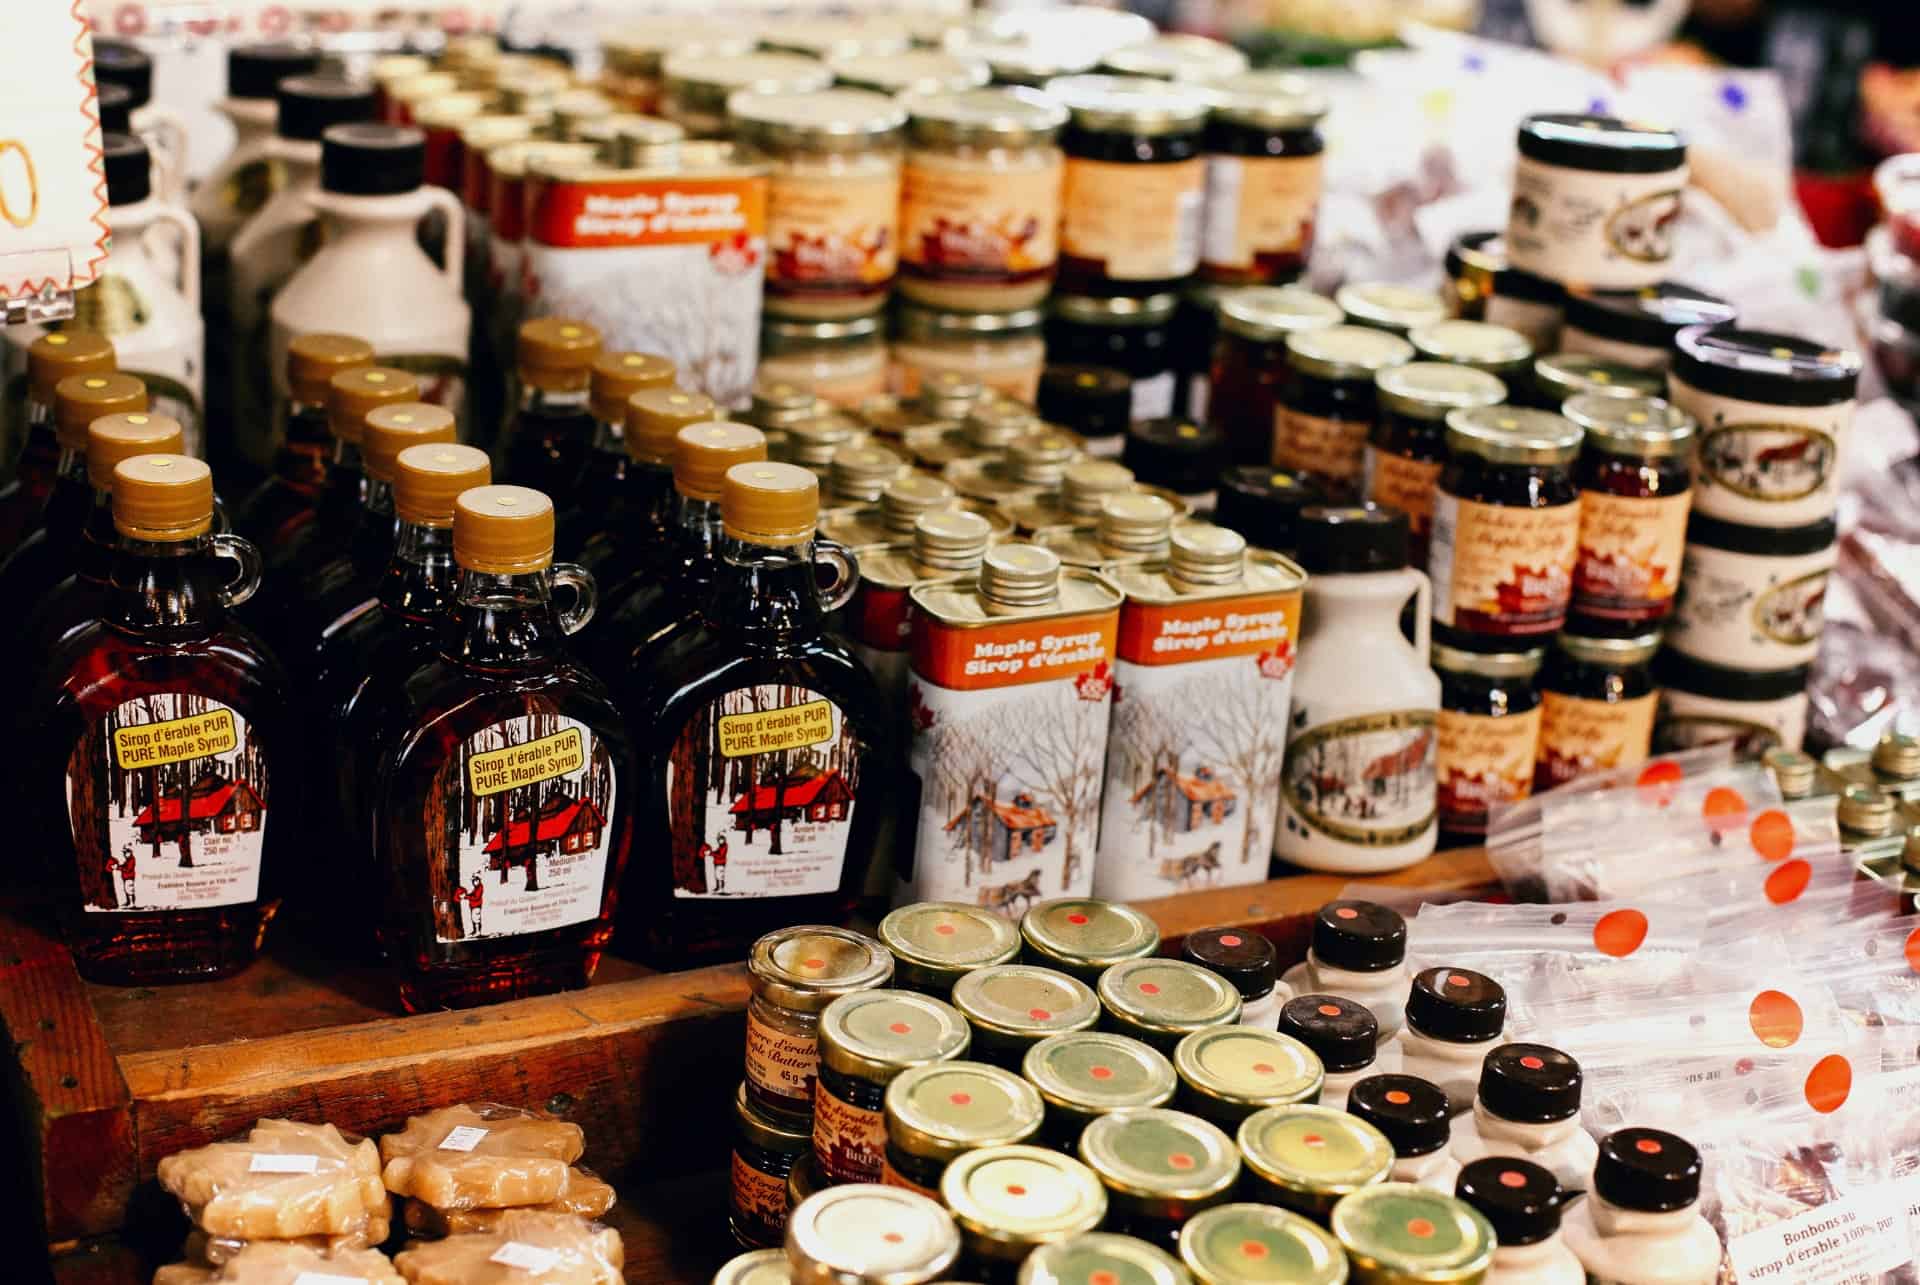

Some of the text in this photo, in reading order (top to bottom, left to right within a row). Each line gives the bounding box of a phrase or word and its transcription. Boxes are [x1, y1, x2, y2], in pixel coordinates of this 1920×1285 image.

[1161, 610, 1285, 635] Maple Syrup
[974, 631, 1101, 658] Maple Syrup
[1152, 635, 1209, 653] Sirop
[964, 658, 1024, 675] Sirop
[119, 715, 229, 748] Sirop d'érable PUR
[723, 707, 827, 735] Sirop d'érable PUR
[122, 734, 230, 763] PURE Maple Syrup
[725, 725, 827, 751] PURE Maple Syrup
[474, 734, 577, 774] Sirop d'érable PUR
[476, 753, 578, 791] PURE Maple Syrup
[768, 1050, 812, 1069] Butter
[780, 1069, 800, 1086] 45 g
[1783, 1211, 1857, 1246] Bonbons au
[1749, 1259, 1784, 1280] sirop
